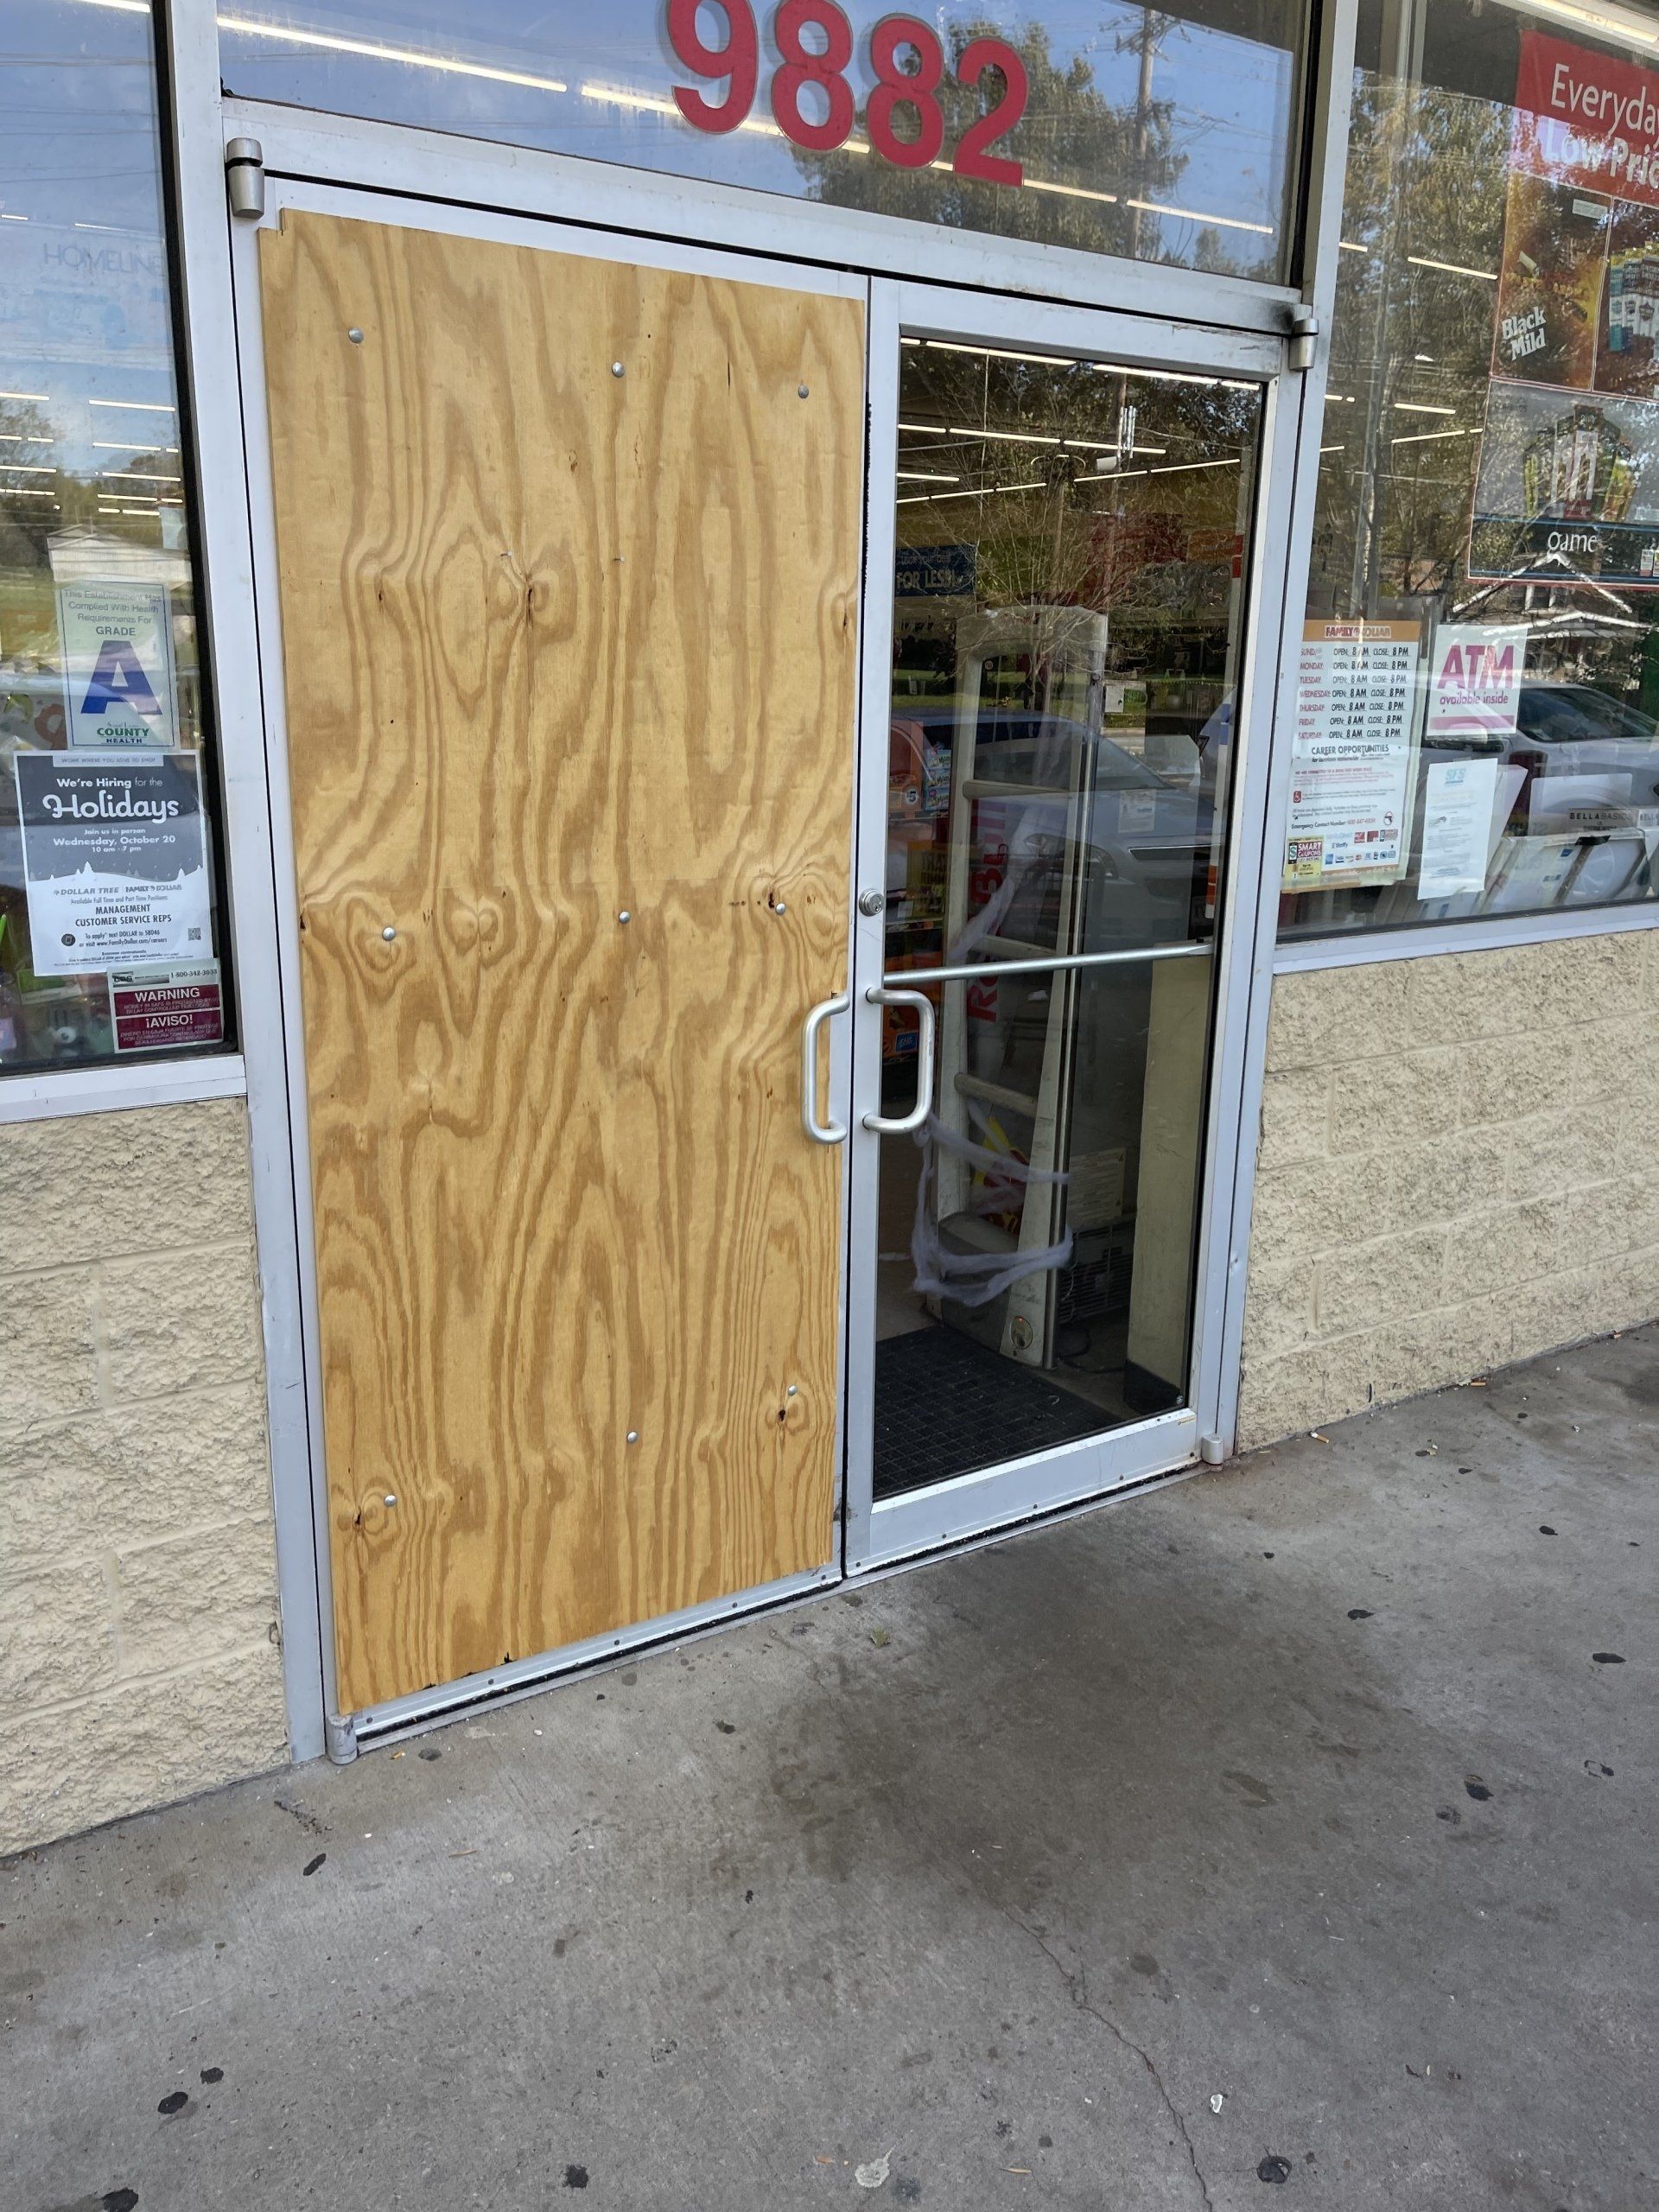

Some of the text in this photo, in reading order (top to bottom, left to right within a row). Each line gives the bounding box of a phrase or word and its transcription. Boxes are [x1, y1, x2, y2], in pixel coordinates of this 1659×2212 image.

[668, 0, 1028, 187] 9882
[1544, 118, 1606, 172] Low
[1502, 306, 1547, 340] Black
[1510, 327, 1547, 361] Mild
[66, 589, 82, 599] This
[111, 603, 130, 612] With
[78, 613, 136, 624] Requirements
[96, 626, 137, 636] GRADE
[1398, 647, 1408, 656] PM
[1437, 645, 1514, 690] ATM
[80, 639, 163, 715] A
[1355, 689, 1367, 697] AM
[1395, 688, 1405, 696] PM
[1440, 690, 1509, 705] available inside
[1354, 702, 1365, 711] AM
[1394, 702, 1404, 710] PM
[97, 728, 149, 737] COUNTY
[1351, 729, 1363, 738] AM
[1390, 728, 1401, 737] PM
[1312, 744, 1389, 755] CAREER OPPORTUNITIES
[56, 777, 163, 788] We're Hiring for the
[42, 790, 180, 823] Holidays
[53, 837, 118, 846] Wednesday,
[119, 836, 160, 844] October
[1298, 842, 1321, 850] SMART
[95, 904, 151, 915] MANAGEMENT
[75, 914, 172, 927] CUSTOMER SERVICE REPS
[135, 988, 200, 1002] WARNING
[145, 1014, 194, 1028] ¡AVISO!
